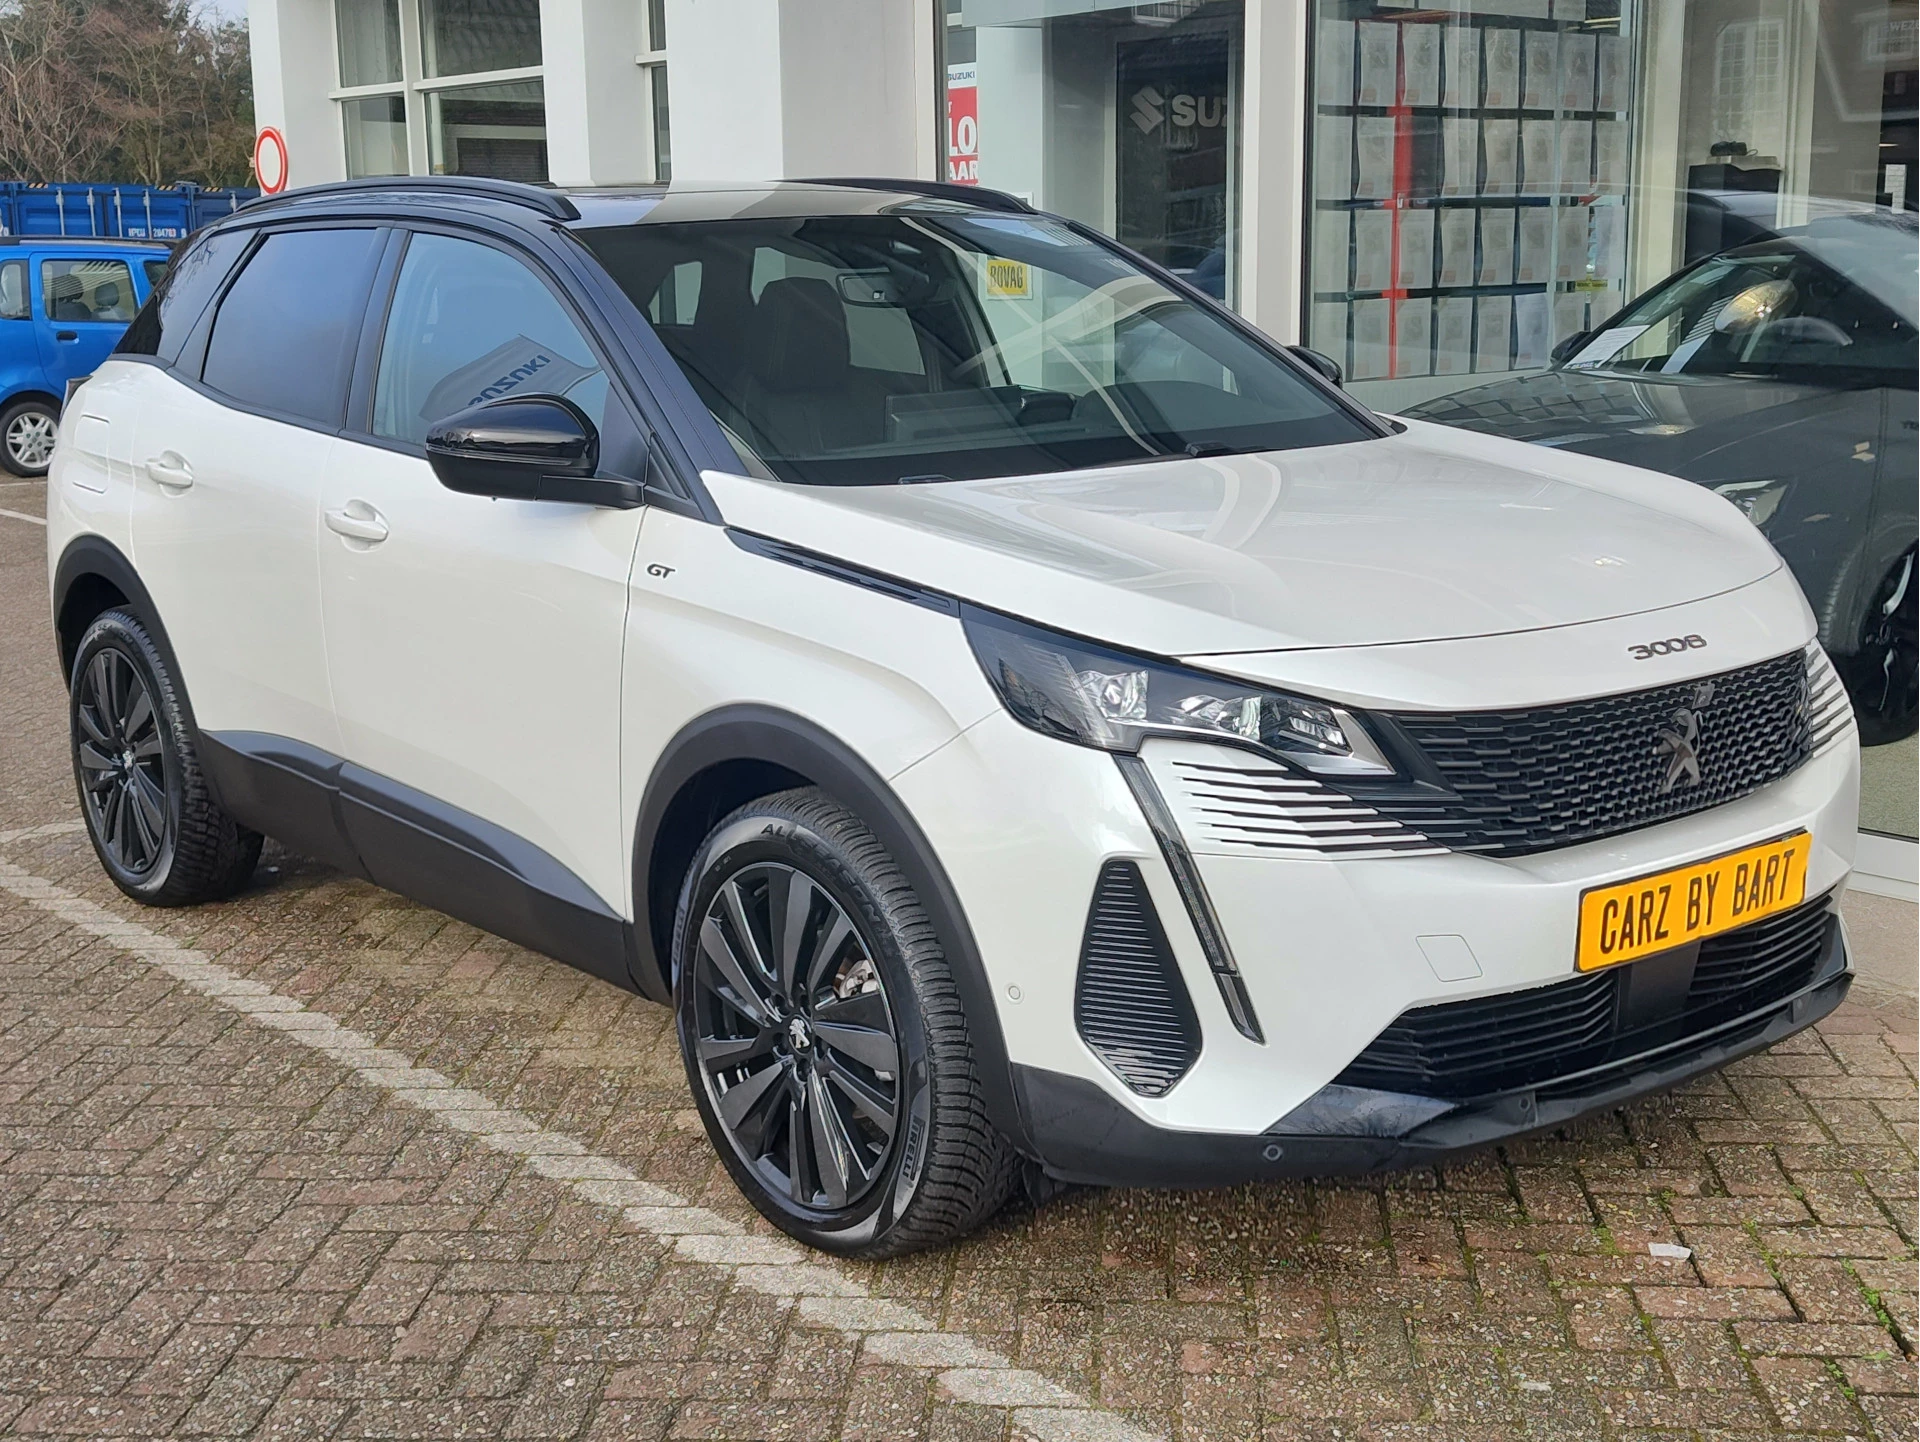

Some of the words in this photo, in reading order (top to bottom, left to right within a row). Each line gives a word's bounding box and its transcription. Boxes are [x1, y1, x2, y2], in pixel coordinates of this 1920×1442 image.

[1171, 94, 1227, 128] SU
[990, 264, 1024, 289] BOVAG
[646, 563, 676, 579] GT
[1627, 634, 1708, 660] 3008
[1600, 884, 1672, 955] CARZ
[1686, 870, 1720, 932] BY
[1732, 848, 1796, 918] BART
